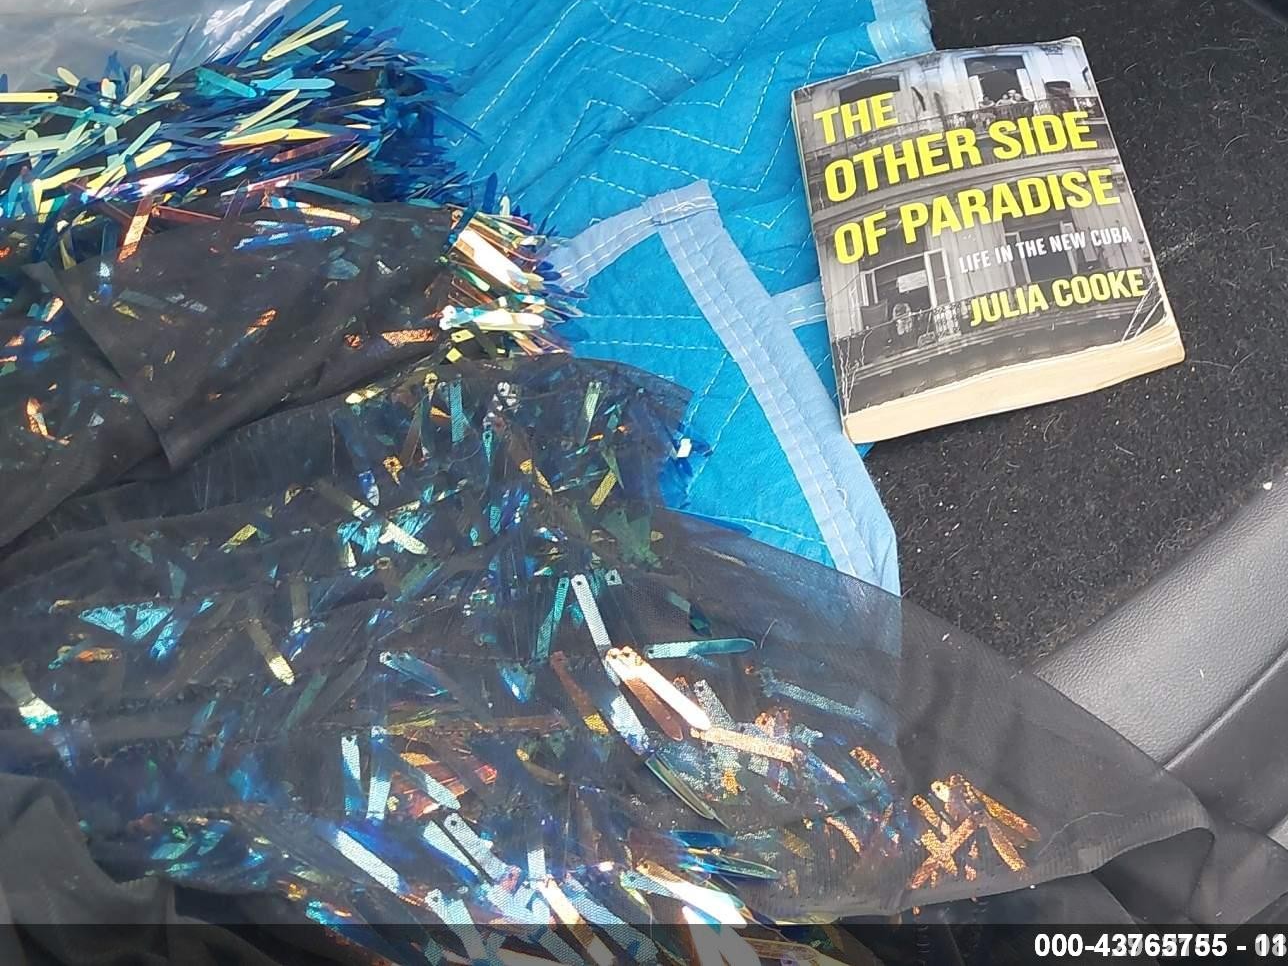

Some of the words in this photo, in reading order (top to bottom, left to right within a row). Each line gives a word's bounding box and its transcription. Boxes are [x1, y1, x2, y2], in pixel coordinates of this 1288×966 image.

[814, 91, 898, 145] THE
[824, 128, 982, 202] OTHER
[988, 111, 1098, 160] SIDE
[834, 210, 887, 265] OF
[900, 168, 1120, 244] PARADISE
[959, 250, 991, 274] LIFE
[995, 244, 1013, 265] IN
[1016, 237, 1047, 260] THE
[1050, 231, 1086, 253] NEW
[1091, 226, 1132, 247] CUBA
[970, 283, 1049, 327] JULIA
[1052, 268, 1149, 308] COOKE
